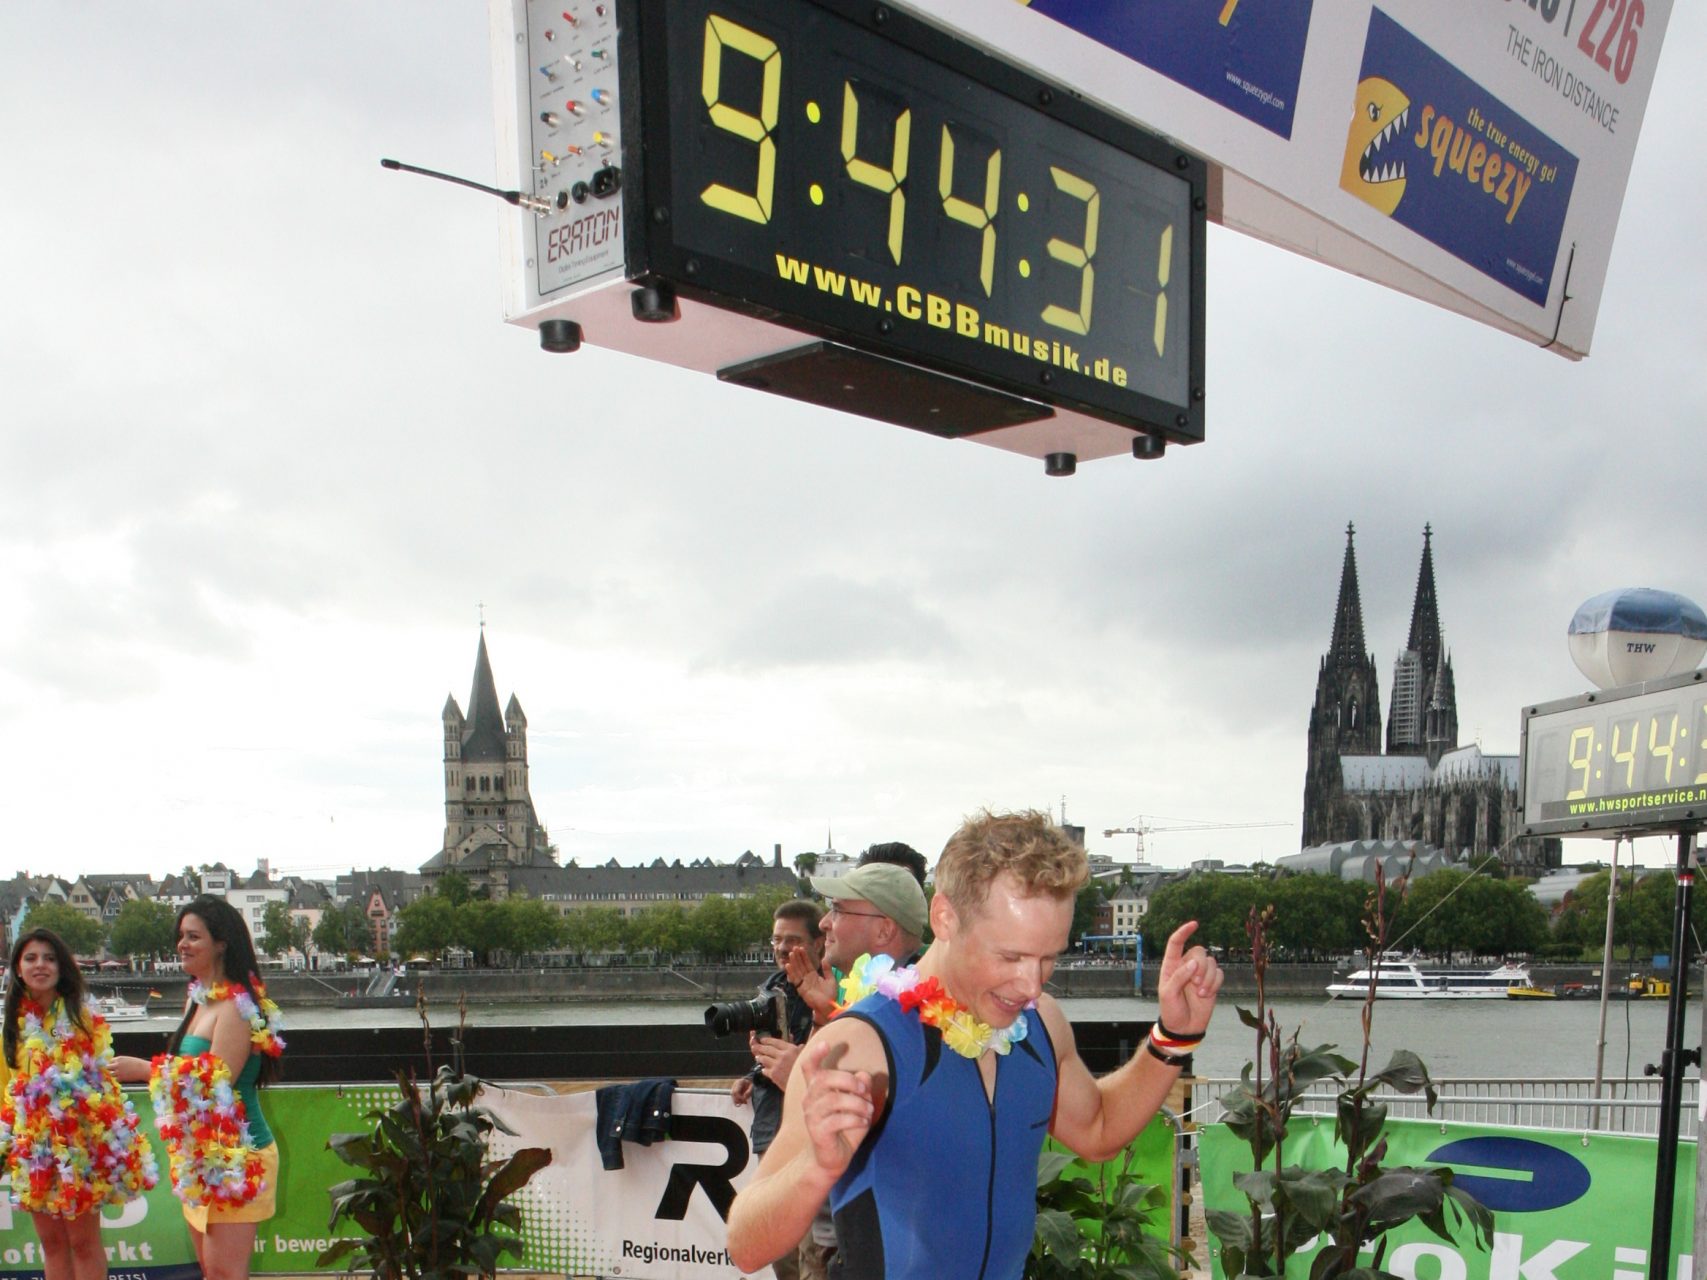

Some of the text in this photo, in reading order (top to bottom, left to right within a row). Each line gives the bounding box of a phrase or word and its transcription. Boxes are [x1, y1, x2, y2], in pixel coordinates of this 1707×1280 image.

[1505, 24, 1620, 134] THE IRON DISTANCE
[700, 14, 1173, 358] 9:44:31
[1414, 104, 1532, 225] squeezy
[1467, 107, 1558, 183] the true energy gel
[547, 205, 620, 264] ERATON
[775, 254, 1128, 388] www.CBBmusik.de
[1626, 642, 1657, 654] THW
[253, 1234, 267, 1253] ir
